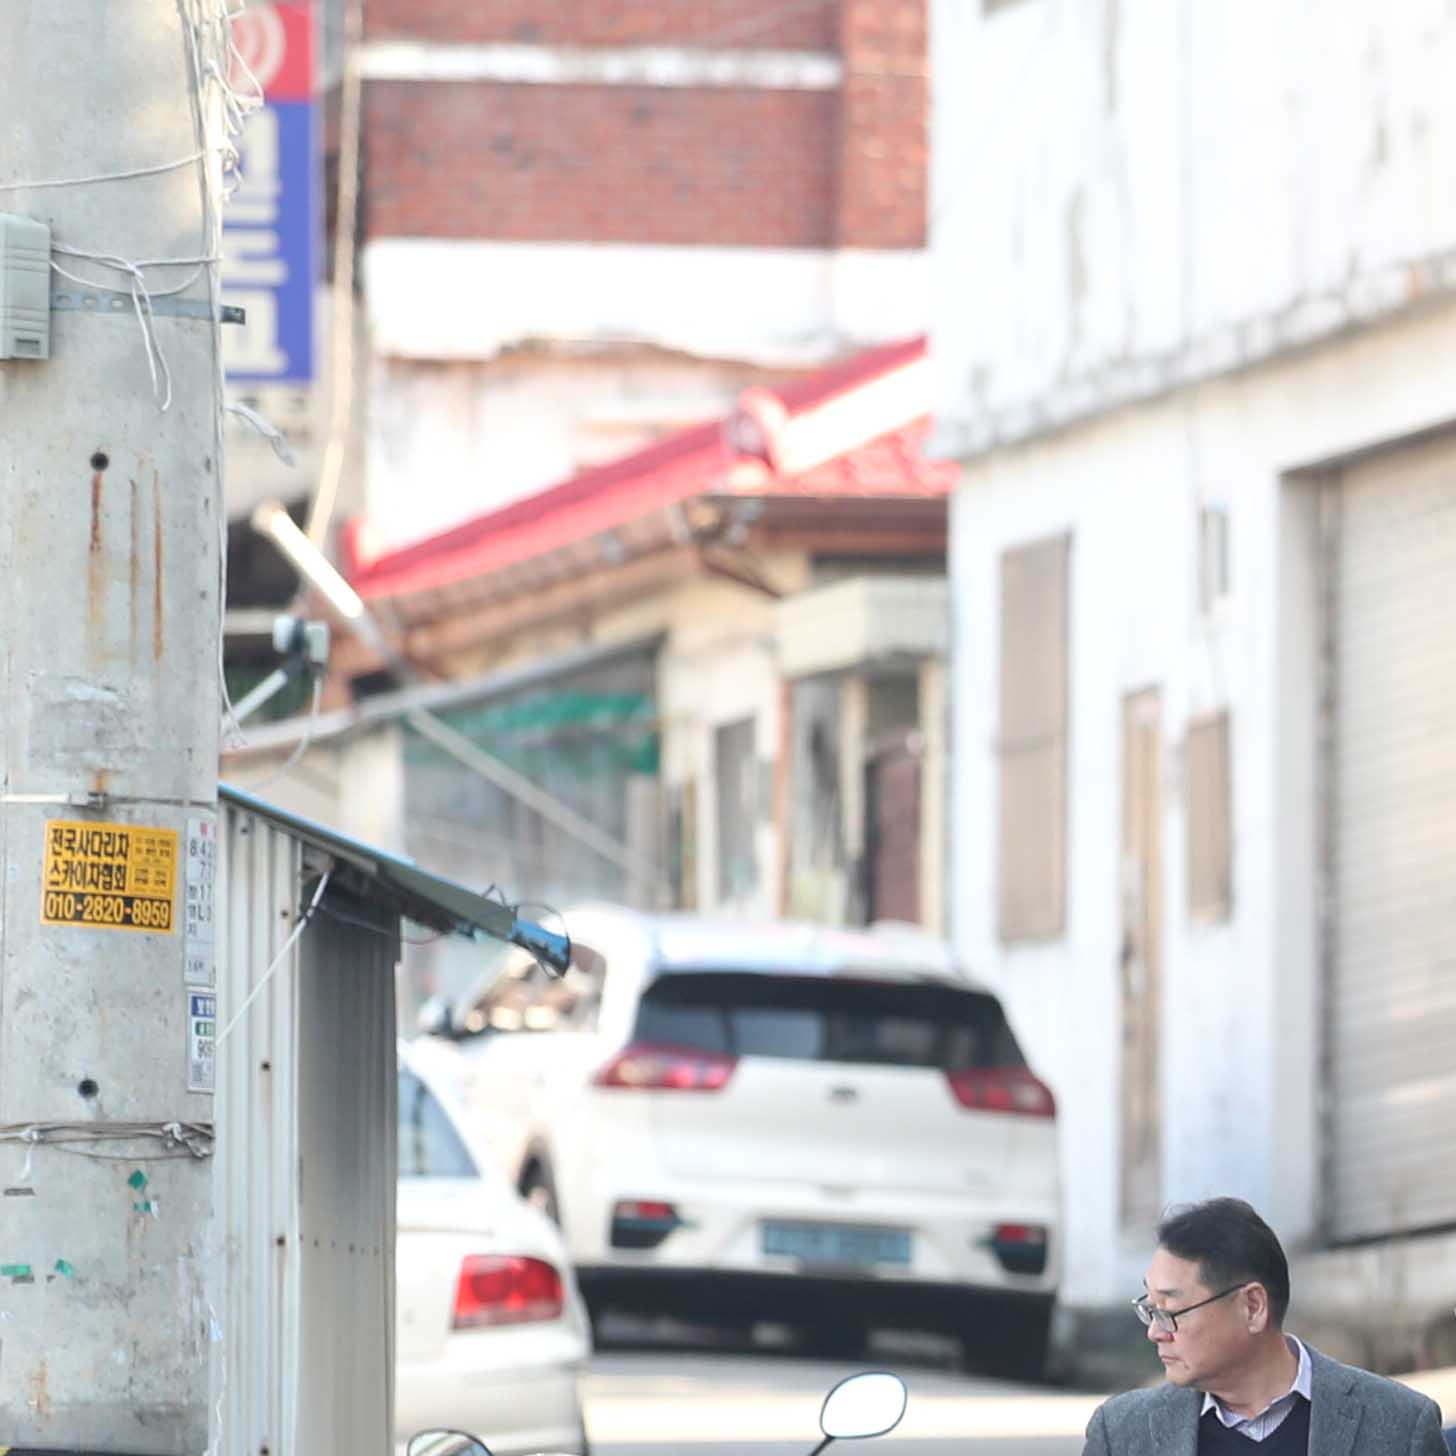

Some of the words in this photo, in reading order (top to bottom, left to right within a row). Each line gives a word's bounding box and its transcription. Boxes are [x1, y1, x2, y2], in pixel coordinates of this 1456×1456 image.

[51, 828, 130, 861] 전국사다리차
[49, 859, 128, 893] 스카이차협회
[46, 892, 171, 929] 010-2820-8959
